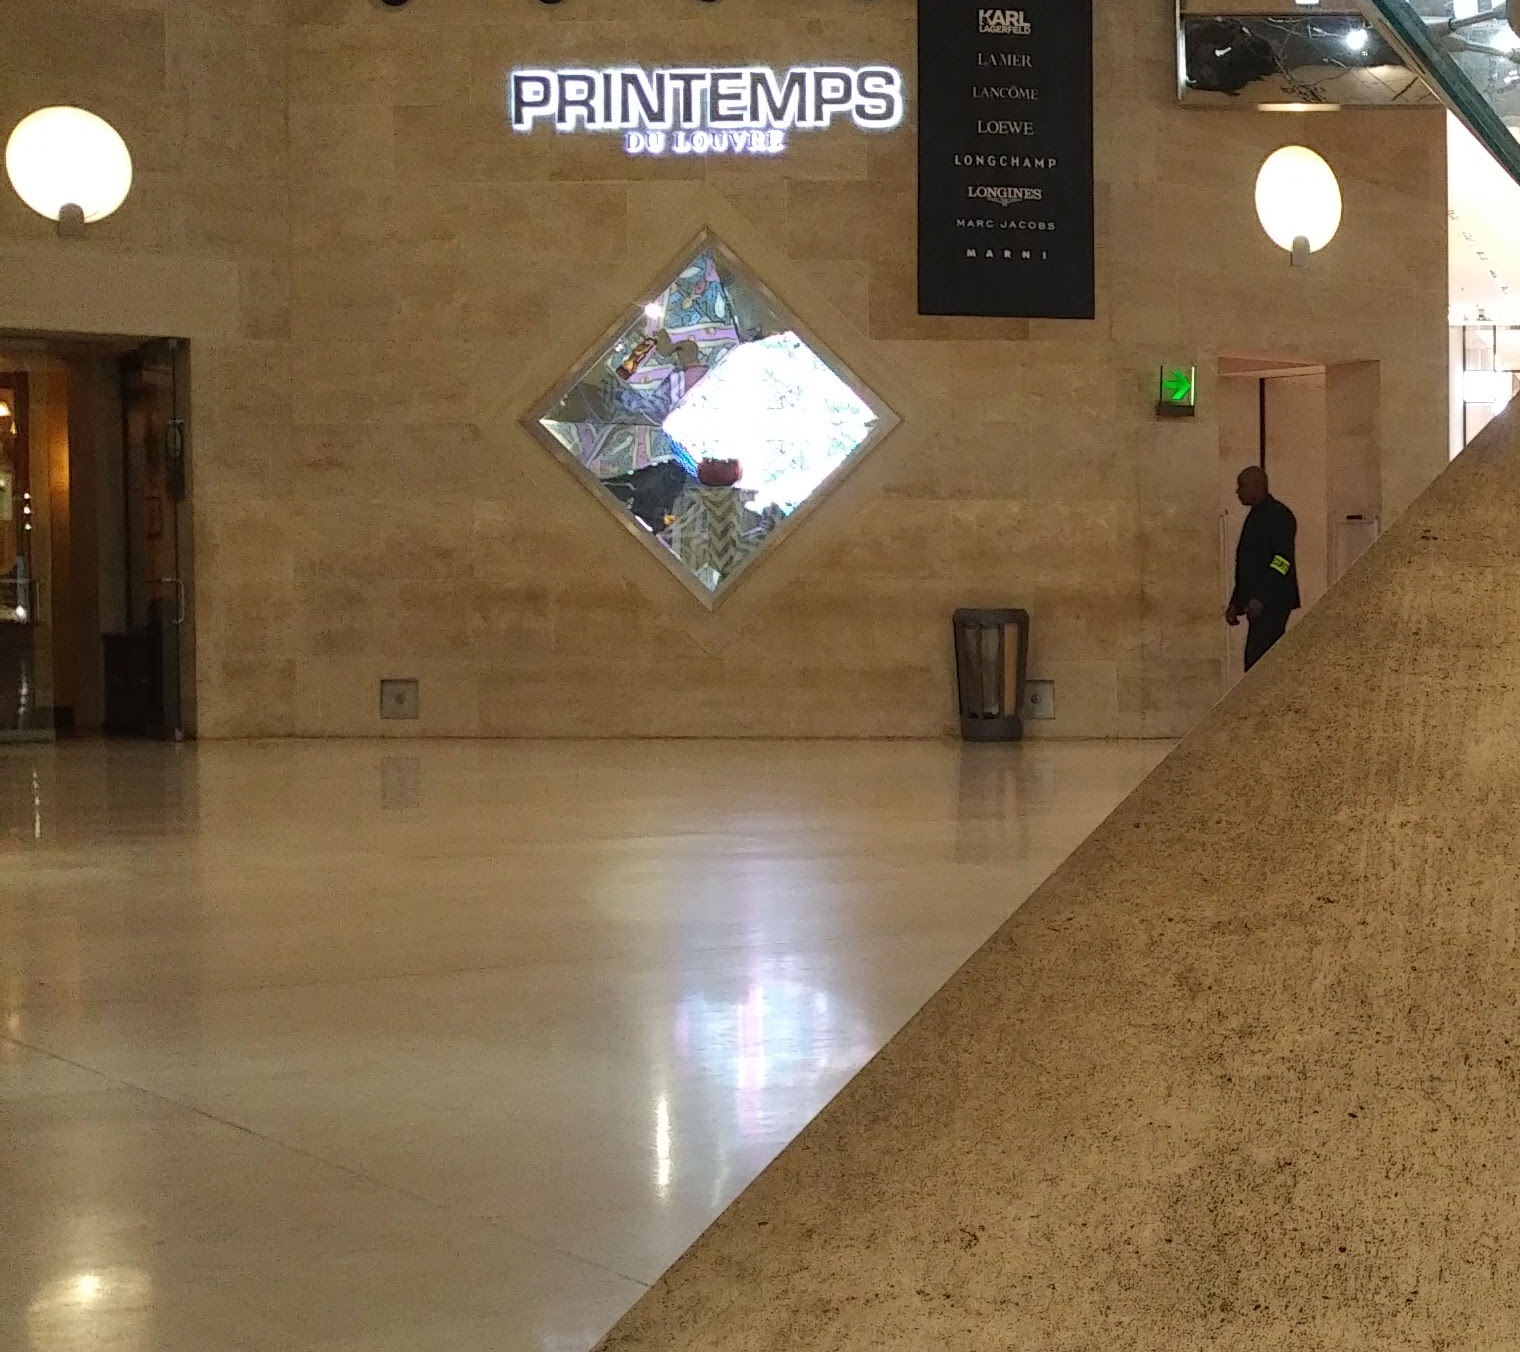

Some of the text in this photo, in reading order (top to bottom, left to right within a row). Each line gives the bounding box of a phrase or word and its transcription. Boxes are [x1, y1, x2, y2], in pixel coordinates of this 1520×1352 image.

[979, 9, 1031, 27] KARL
[979, 25, 1031, 35] LAGERFELD
[509, 68, 900, 129] PRINTEMPS
[972, 85, 1039, 100] LANCÔME
[977, 120, 1035, 136] LOEWE
[623, 130, 787, 154] DU LOUVRE
[954, 154, 1057, 169] LONGCHAMP
[968, 186, 1042, 200] LONGINES
[956, 218, 1056, 231] MARC JACOBS
[966, 248, 1048, 260] MARNI
